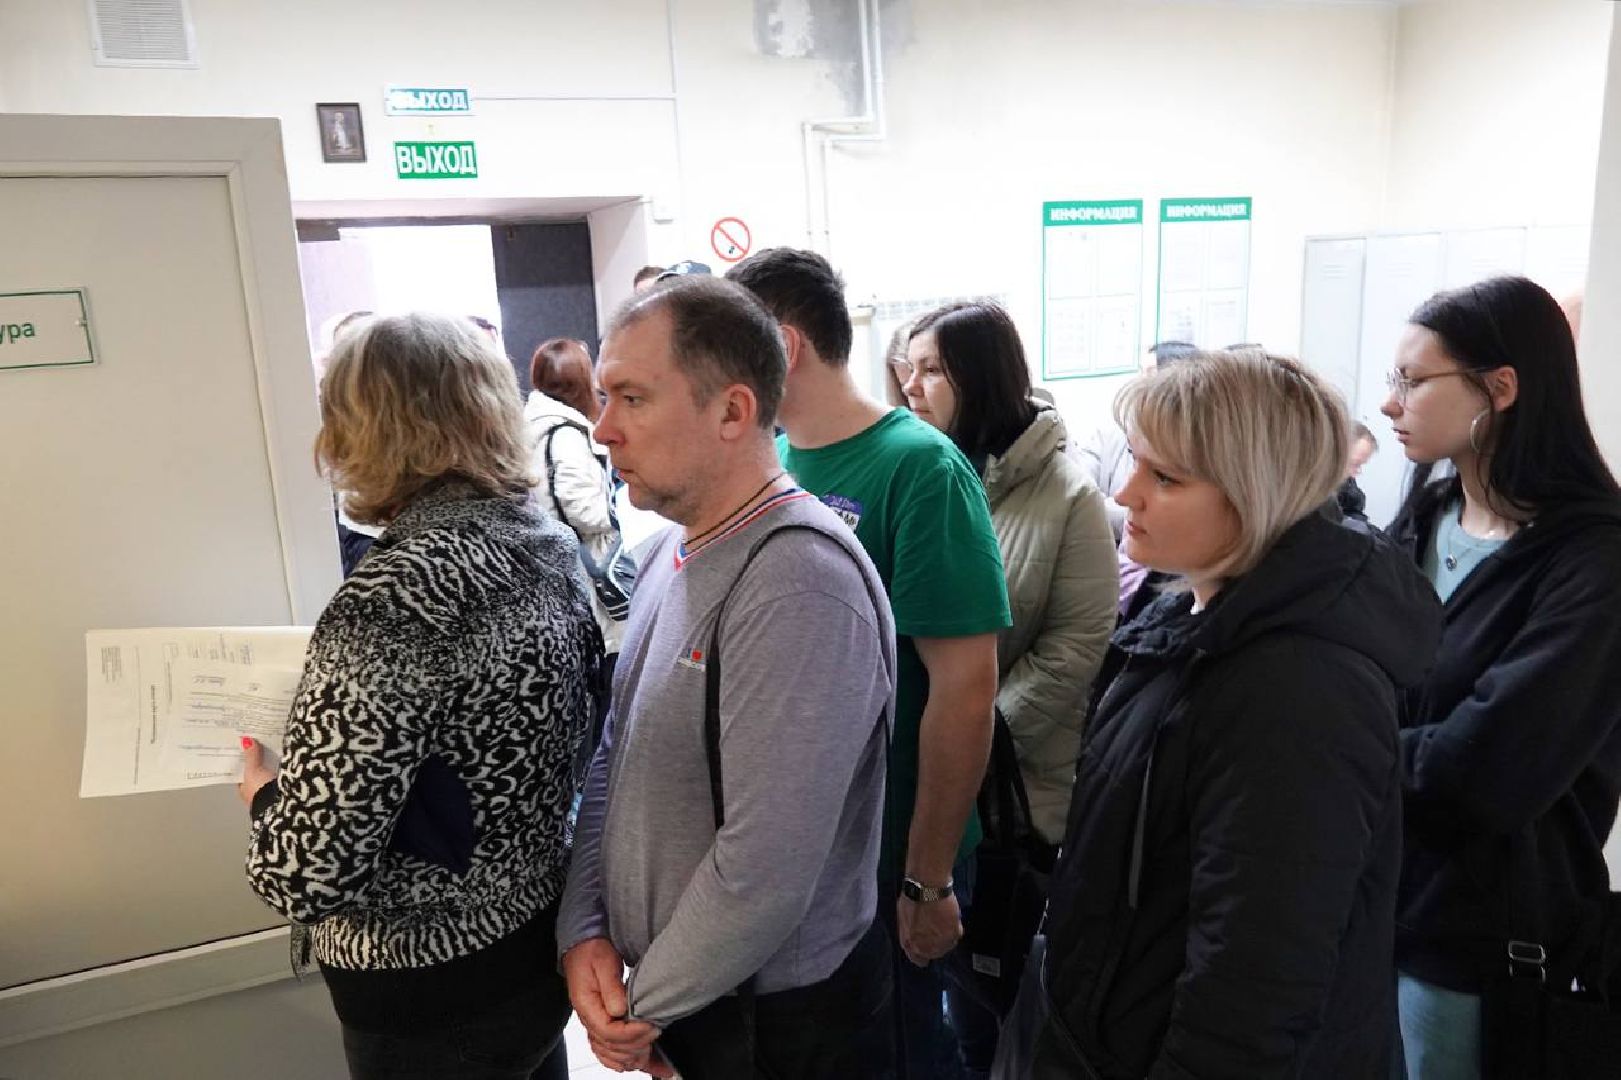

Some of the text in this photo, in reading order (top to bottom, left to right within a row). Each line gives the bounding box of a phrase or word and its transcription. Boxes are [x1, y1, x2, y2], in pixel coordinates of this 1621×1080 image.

[396, 145, 477, 175] ВЫХОД
[1050, 205, 1138, 221] ИНФОРМАЦИЯ
[1166, 203, 1247, 217] ИНФОРМАЦИЯ
